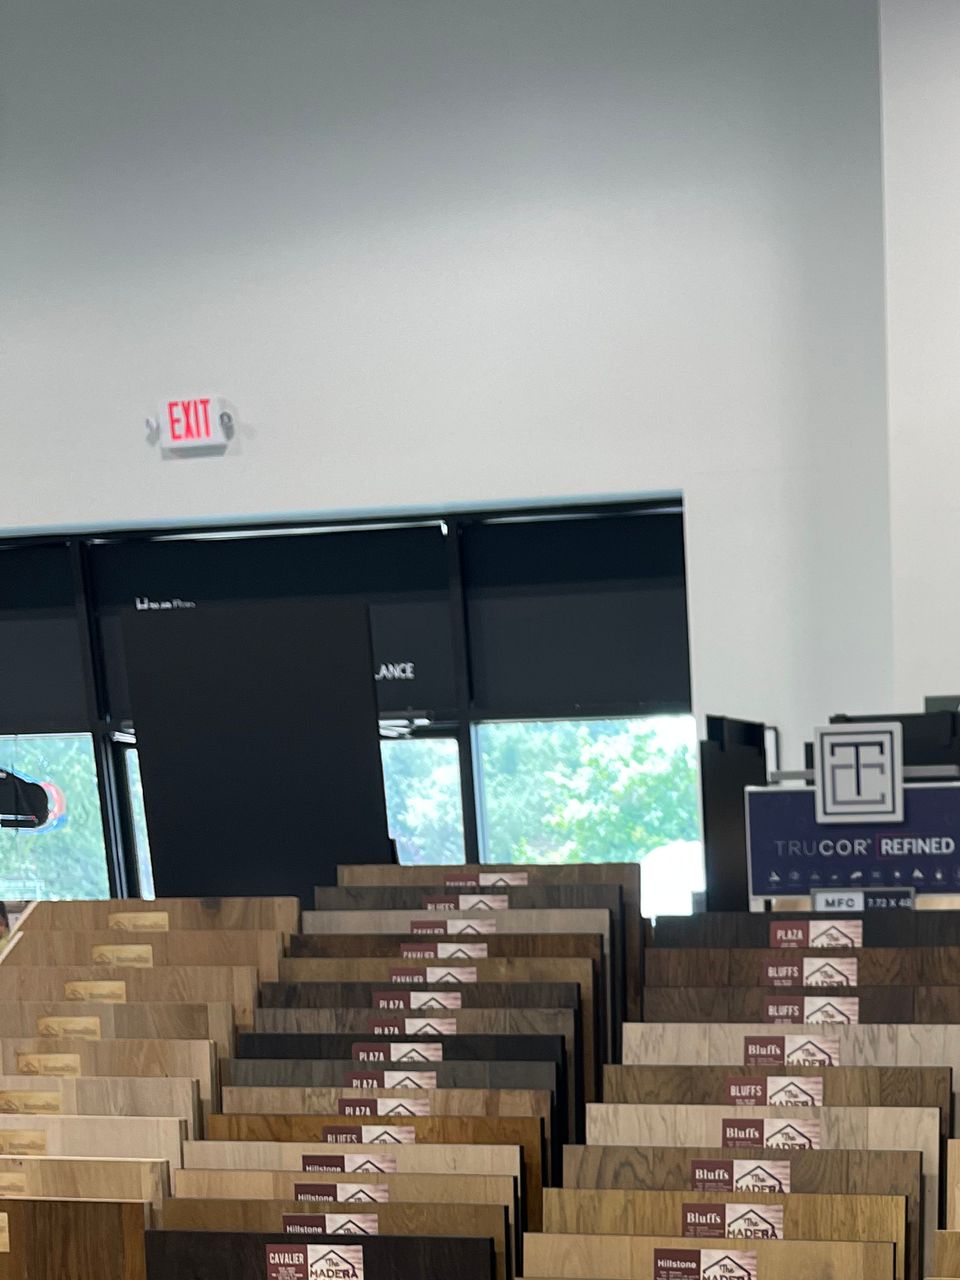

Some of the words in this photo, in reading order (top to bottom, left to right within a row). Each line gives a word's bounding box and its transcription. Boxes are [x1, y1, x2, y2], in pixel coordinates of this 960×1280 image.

[168, 399, 210, 440] EXIT
[881, 838, 955, 855] REFINED
[825, 897, 855, 908] MFC
[776, 929, 803, 940] PLAZA
[768, 966, 798, 977] BLUFFS
[768, 1005, 799, 1016] BLUFFS
[748, 1045, 781, 1055] Bluffs
[730, 1085, 762, 1096] BLUFFS
[726, 1127, 760, 1138] Bluffs
[695, 1169, 729, 1180] Bluffs
[751, 1173, 766, 1183] The
[687, 1213, 721, 1223] Bluffs
[743, 1217, 759, 1227] The
[286, 1225, 322, 1233] Hillstone
[727, 1228, 778, 1238] MADERA
[269, 1252, 304, 1265] CAVALIER
[325, 1257, 340, 1267] The
[657, 1259, 697, 1269] Hillstone
[310, 1268, 359, 1279] MADERA
[719, 1264, 735, 1274] The
